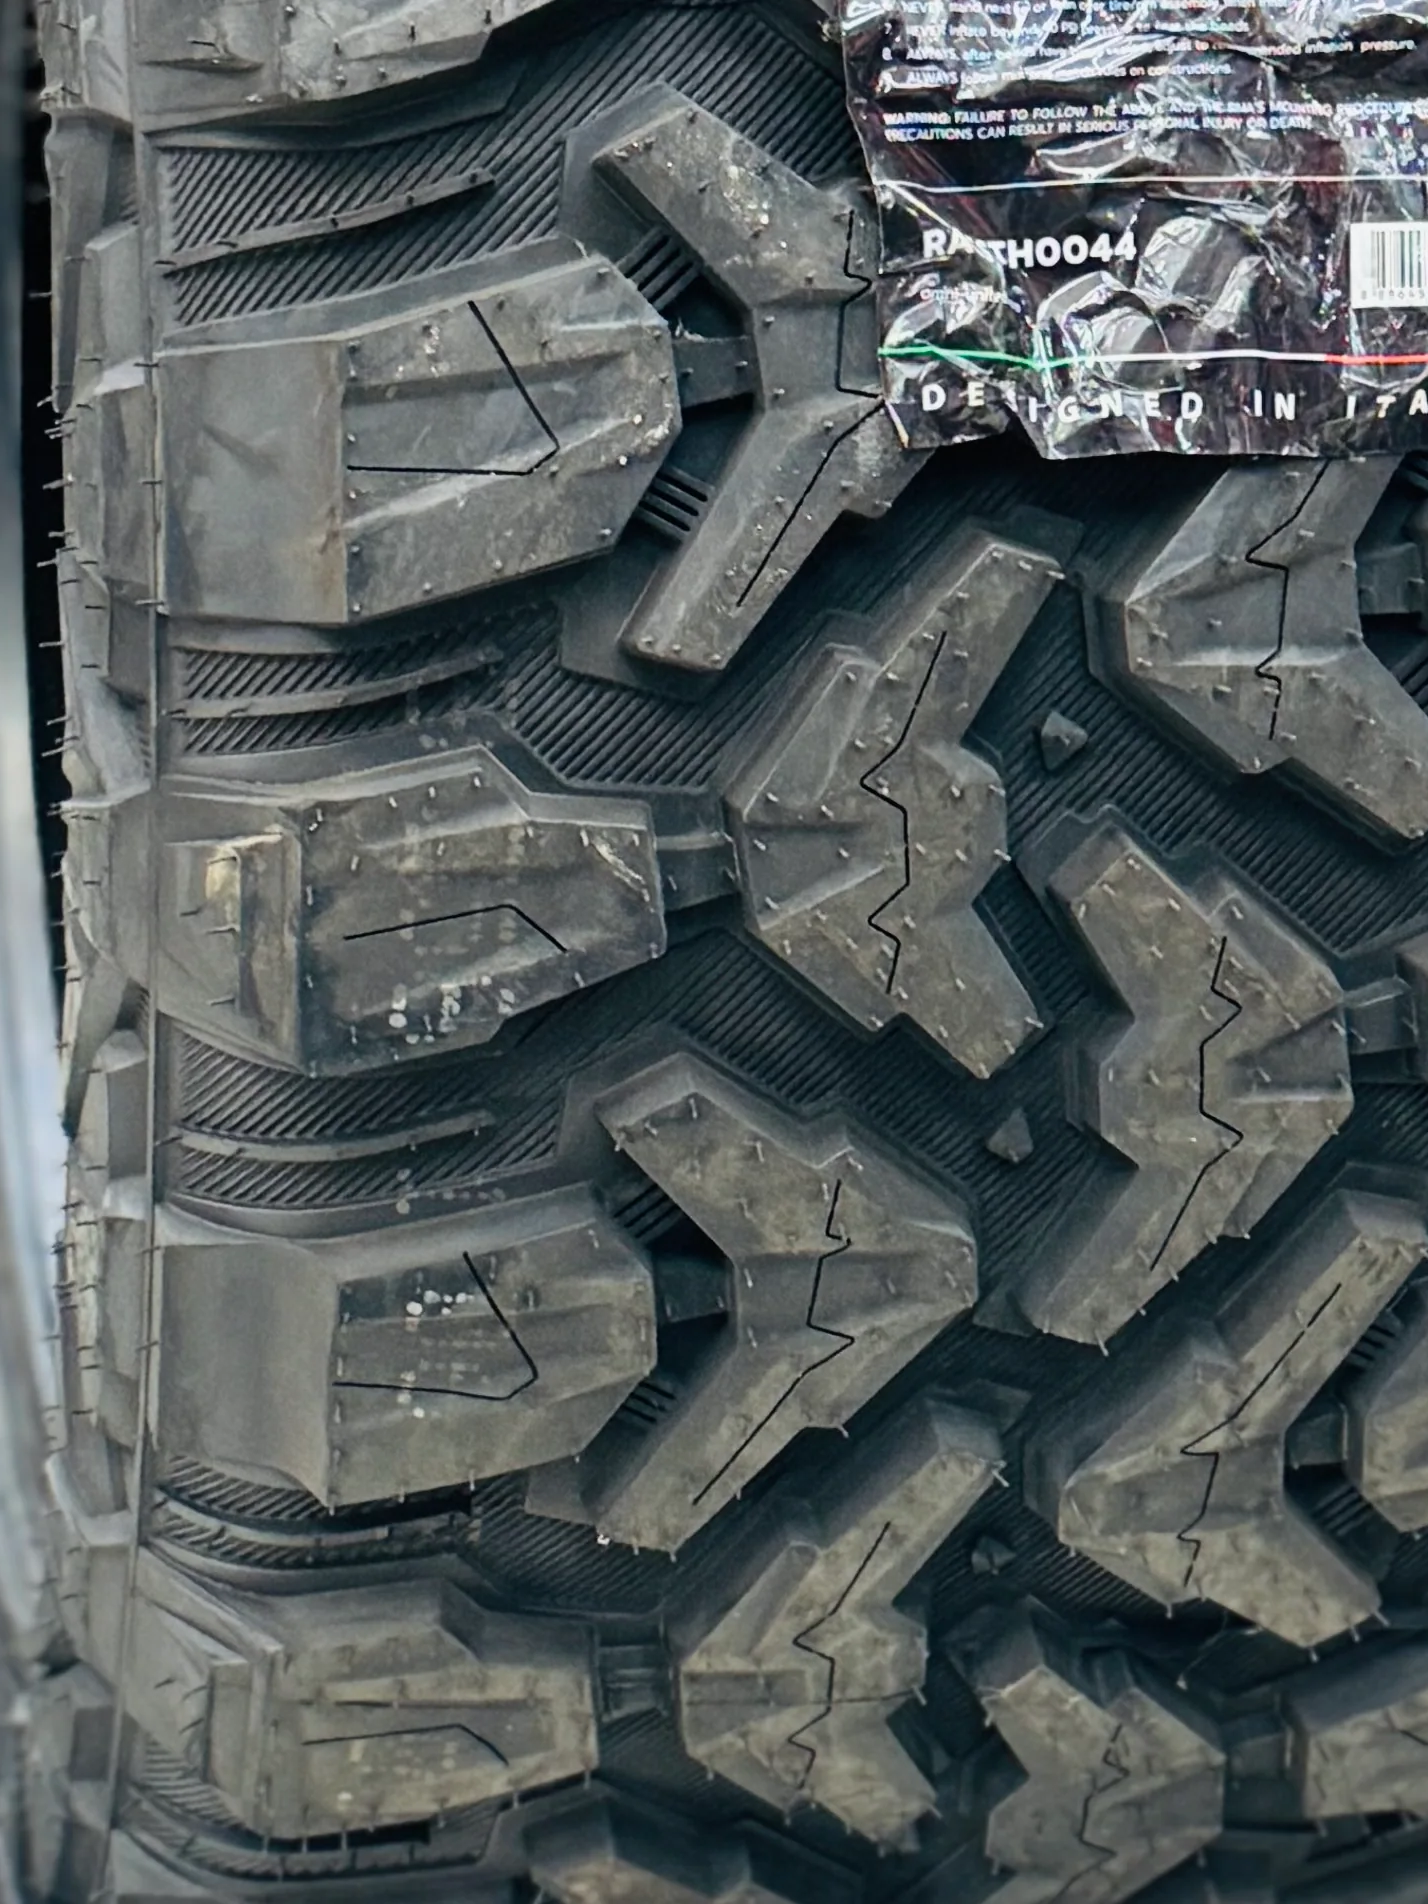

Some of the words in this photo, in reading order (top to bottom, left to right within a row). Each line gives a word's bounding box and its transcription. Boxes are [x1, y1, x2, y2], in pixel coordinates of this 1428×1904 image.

[954, 110, 1005, 124] FAILURE
[1010, 108, 1029, 122] TO
[1033, 106, 1088, 120] FOLLOW
[1092, 103, 1117, 117] THE
[1269, 100, 1333, 117] MOUNTING
[977, 126, 1006, 141] CAN
[1009, 123, 1054, 137] RESULT
[1057, 121, 1072, 133] IN
[1075, 119, 1131, 133] SERIOUS
[922, 227, 1137, 270] RATH0044
[1253, 389, 1296, 421] IN
